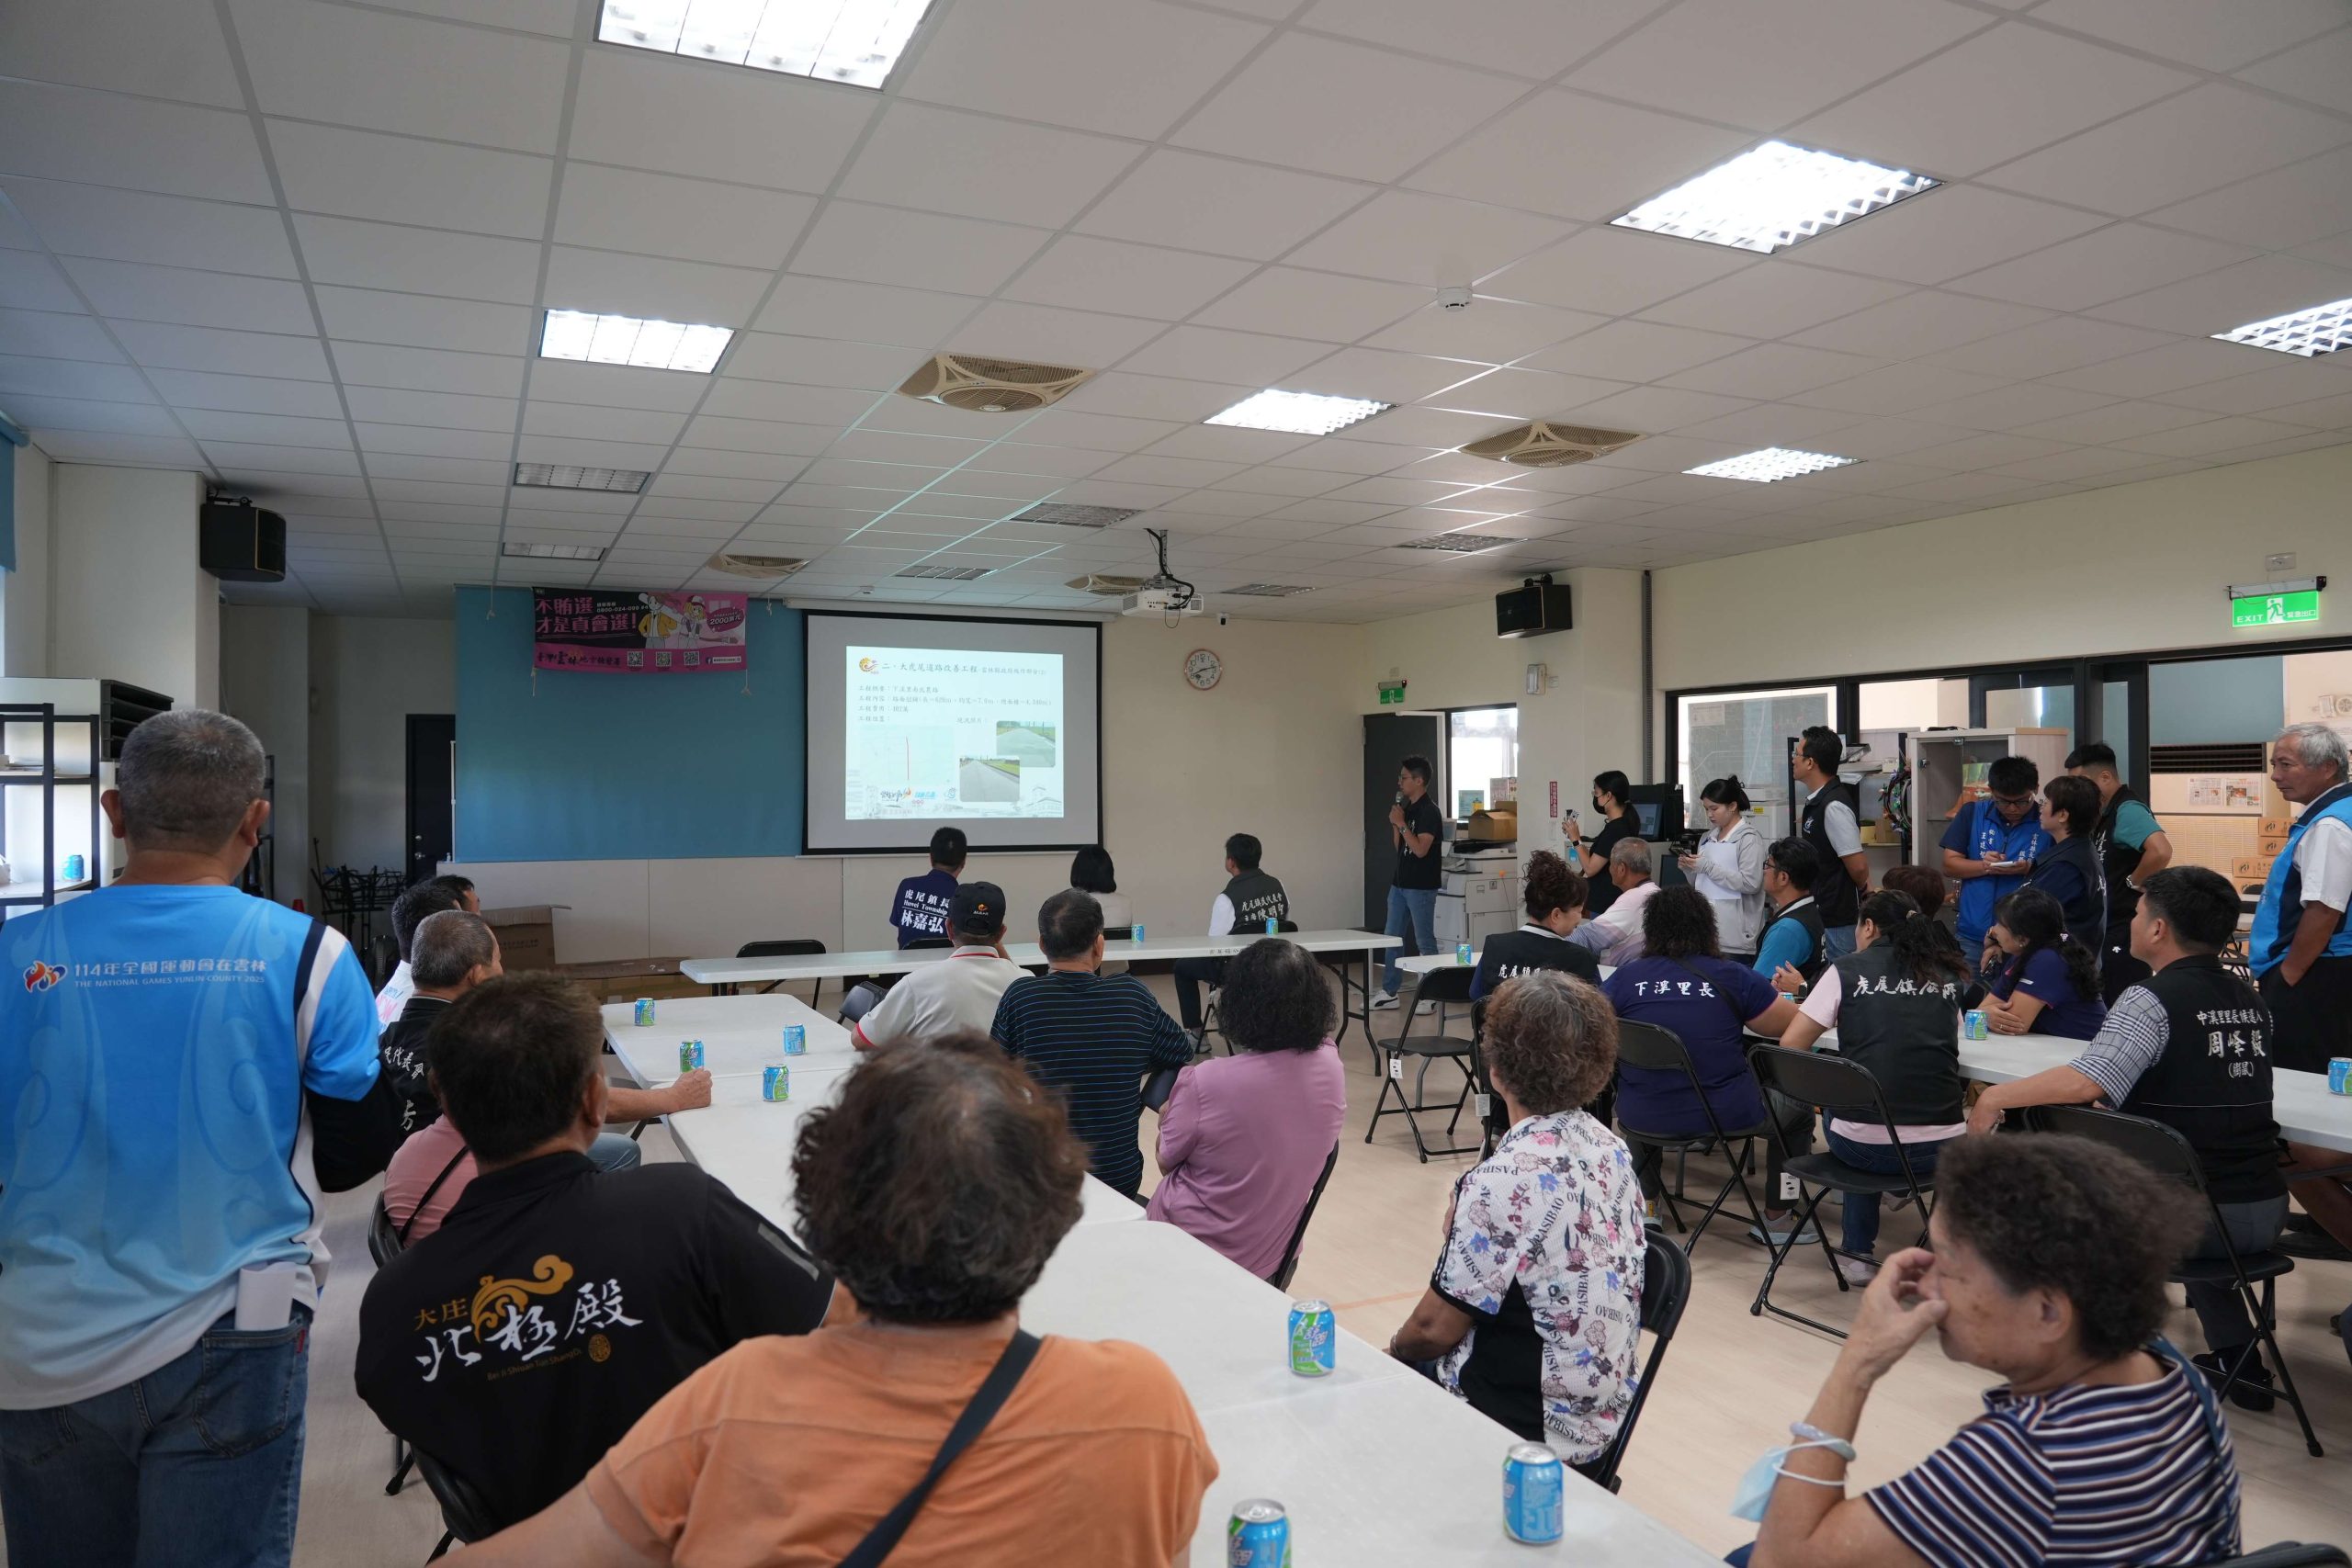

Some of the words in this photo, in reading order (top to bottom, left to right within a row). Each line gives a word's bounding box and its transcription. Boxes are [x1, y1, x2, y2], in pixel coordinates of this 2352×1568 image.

[536, 596, 594, 615] 不賄選
[2236, 614, 2264, 623] EXIT
[904, 888, 950, 908] 虎尾鎮長
[901, 908, 944, 934] 林嘉弘
[74, 958, 266, 977] 114年全國運動會在雲林
[74, 980, 92, 988] THE
[96, 978, 139, 987] NATIONAL
[142, 977, 173, 986] GAMES
[175, 976, 206, 984] YUNLIN
[244, 976, 266, 984] 2025
[1852, 975, 1957, 1001] 虎尾鎮公所
[1533, 1197, 1565, 1246] PASIBAO
[413, 1297, 469, 1332] 大庄
[415, 1278, 644, 1382] 北極殿
